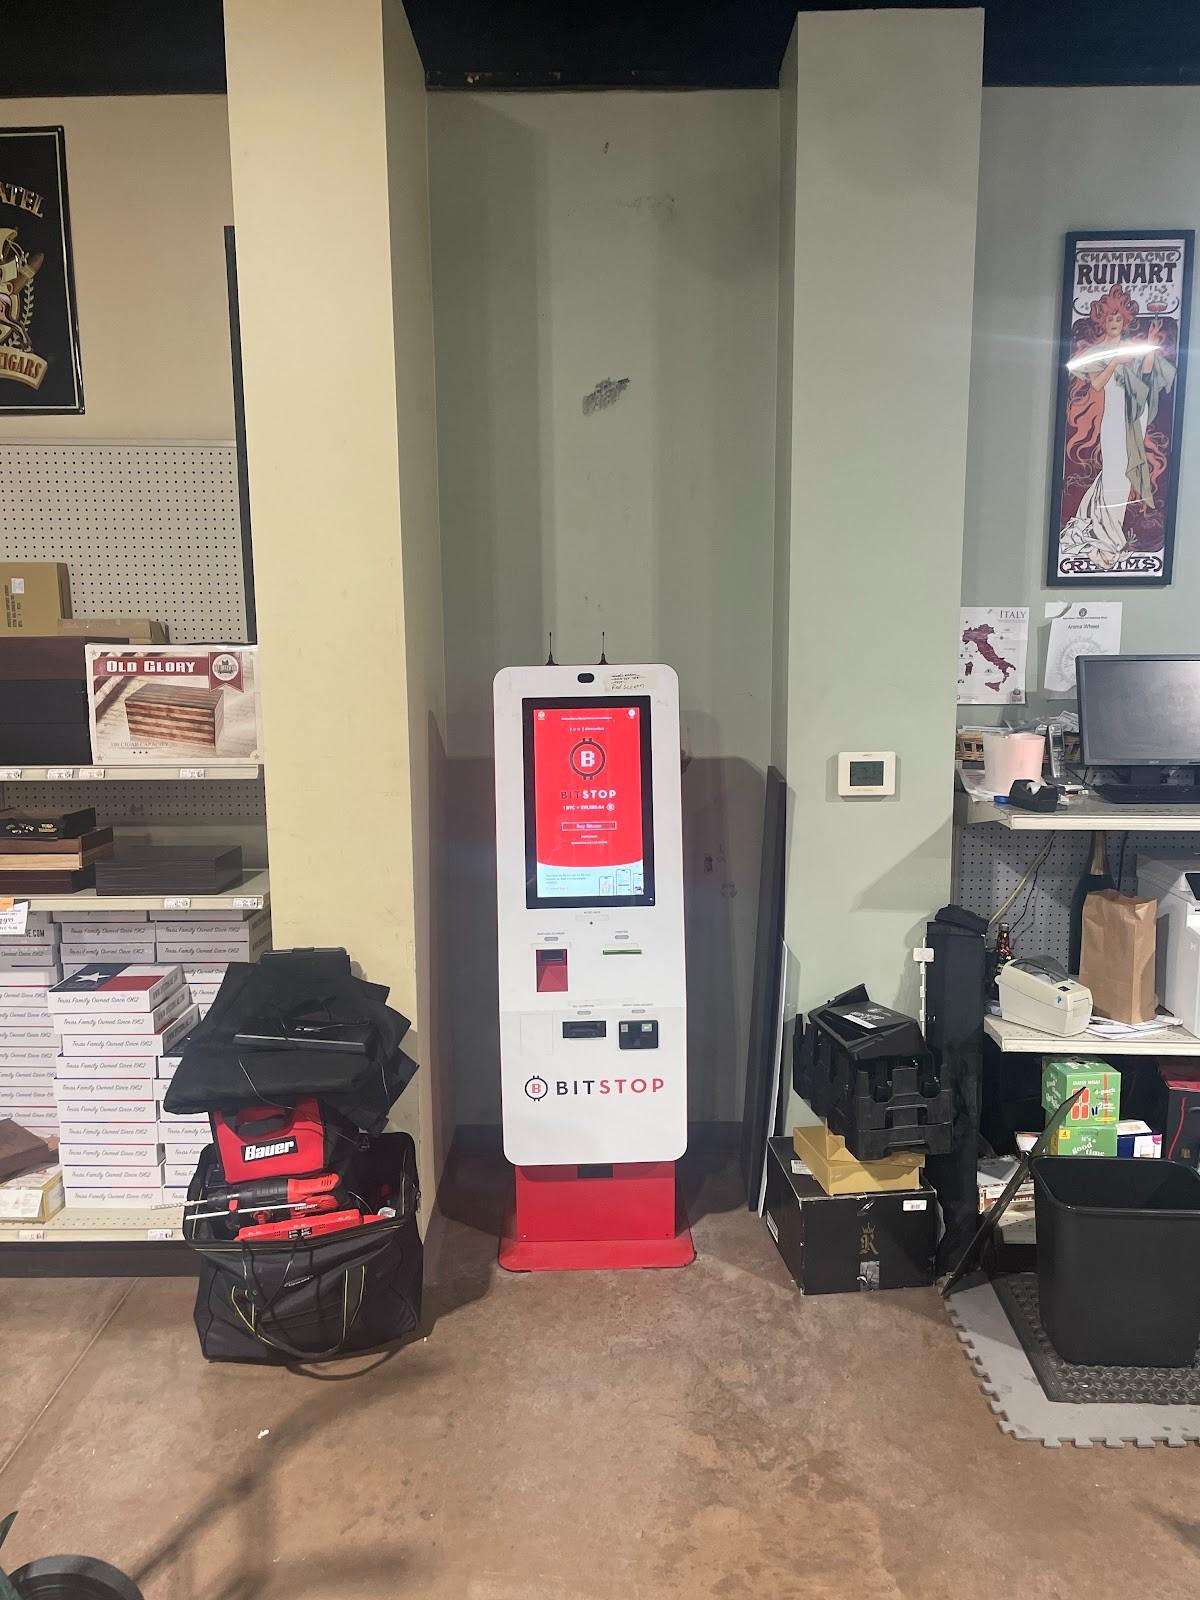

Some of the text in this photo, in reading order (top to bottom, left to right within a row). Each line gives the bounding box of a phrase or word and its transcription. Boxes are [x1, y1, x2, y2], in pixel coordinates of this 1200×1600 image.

[1080, 252, 1176, 263] CHAMPAGNE
[1077, 262, 1177, 285] RUINART
[1065, 560, 1156, 570] RHIMS
[1000, 610, 1026, 619] ITALY
[106, 660, 196, 673] OLD GLORY
[561, 790, 616, 800] BITSTOP
[556, 1078, 664, 1096] BITSTOP
[244, 1140, 295, 1162] Bauer
[1072, 1142, 1092, 1155] good
